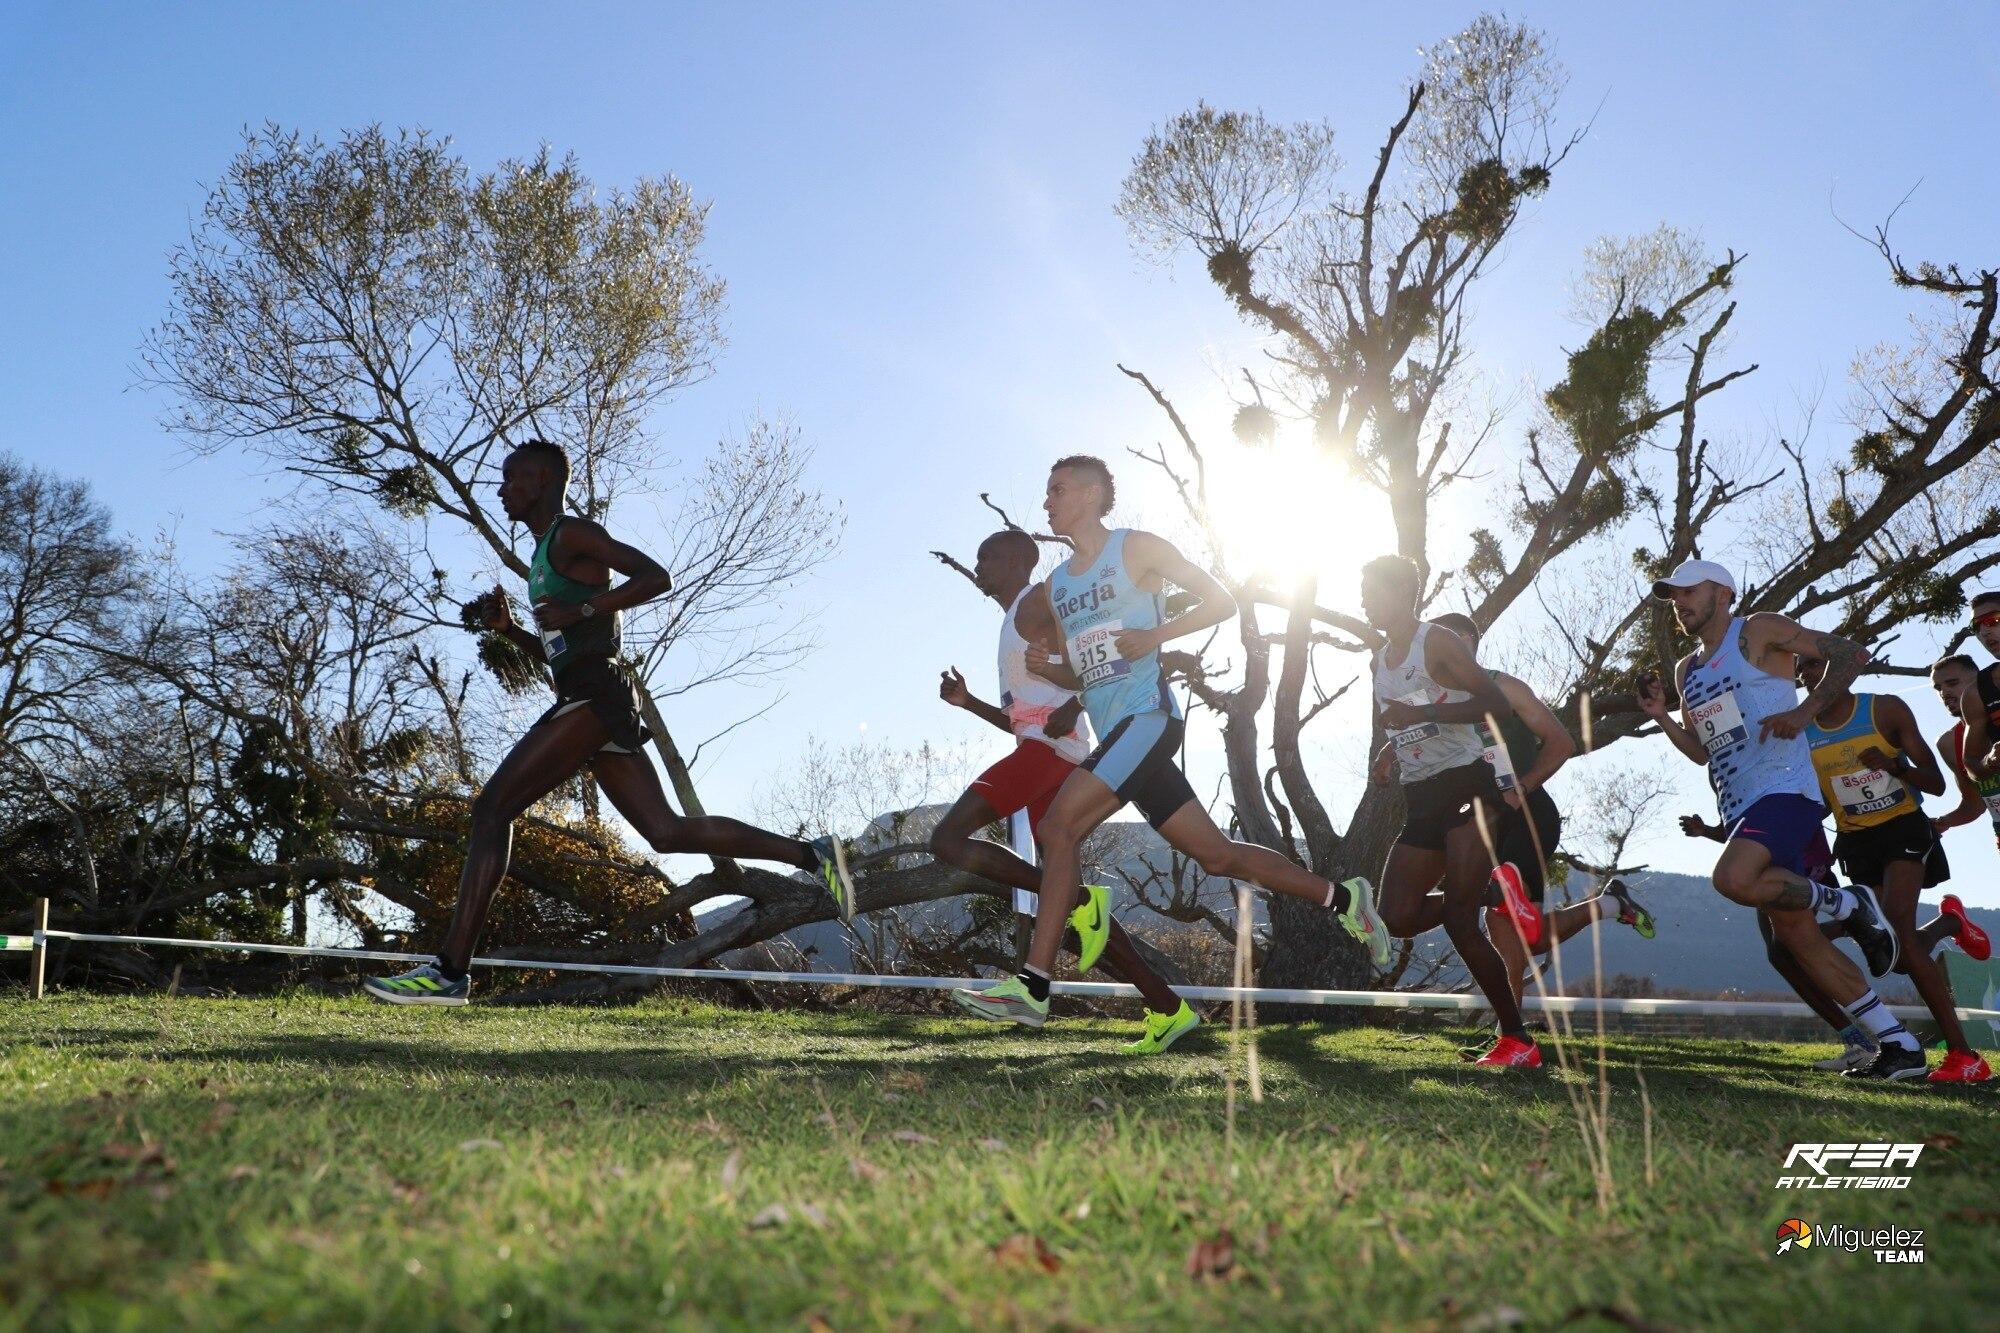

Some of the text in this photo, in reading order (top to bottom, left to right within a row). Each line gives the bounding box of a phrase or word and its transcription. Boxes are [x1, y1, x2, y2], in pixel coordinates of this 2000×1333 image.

[1057, 582, 1116, 619] nerja
[1081, 630, 1108, 648] Soria
[1079, 643, 1107, 670] 315
[1697, 704, 1723, 721] Soria
[1705, 720, 1716, 737] 9
[1852, 770, 1883, 787] Soria
[1861, 785, 1875, 800] 6
